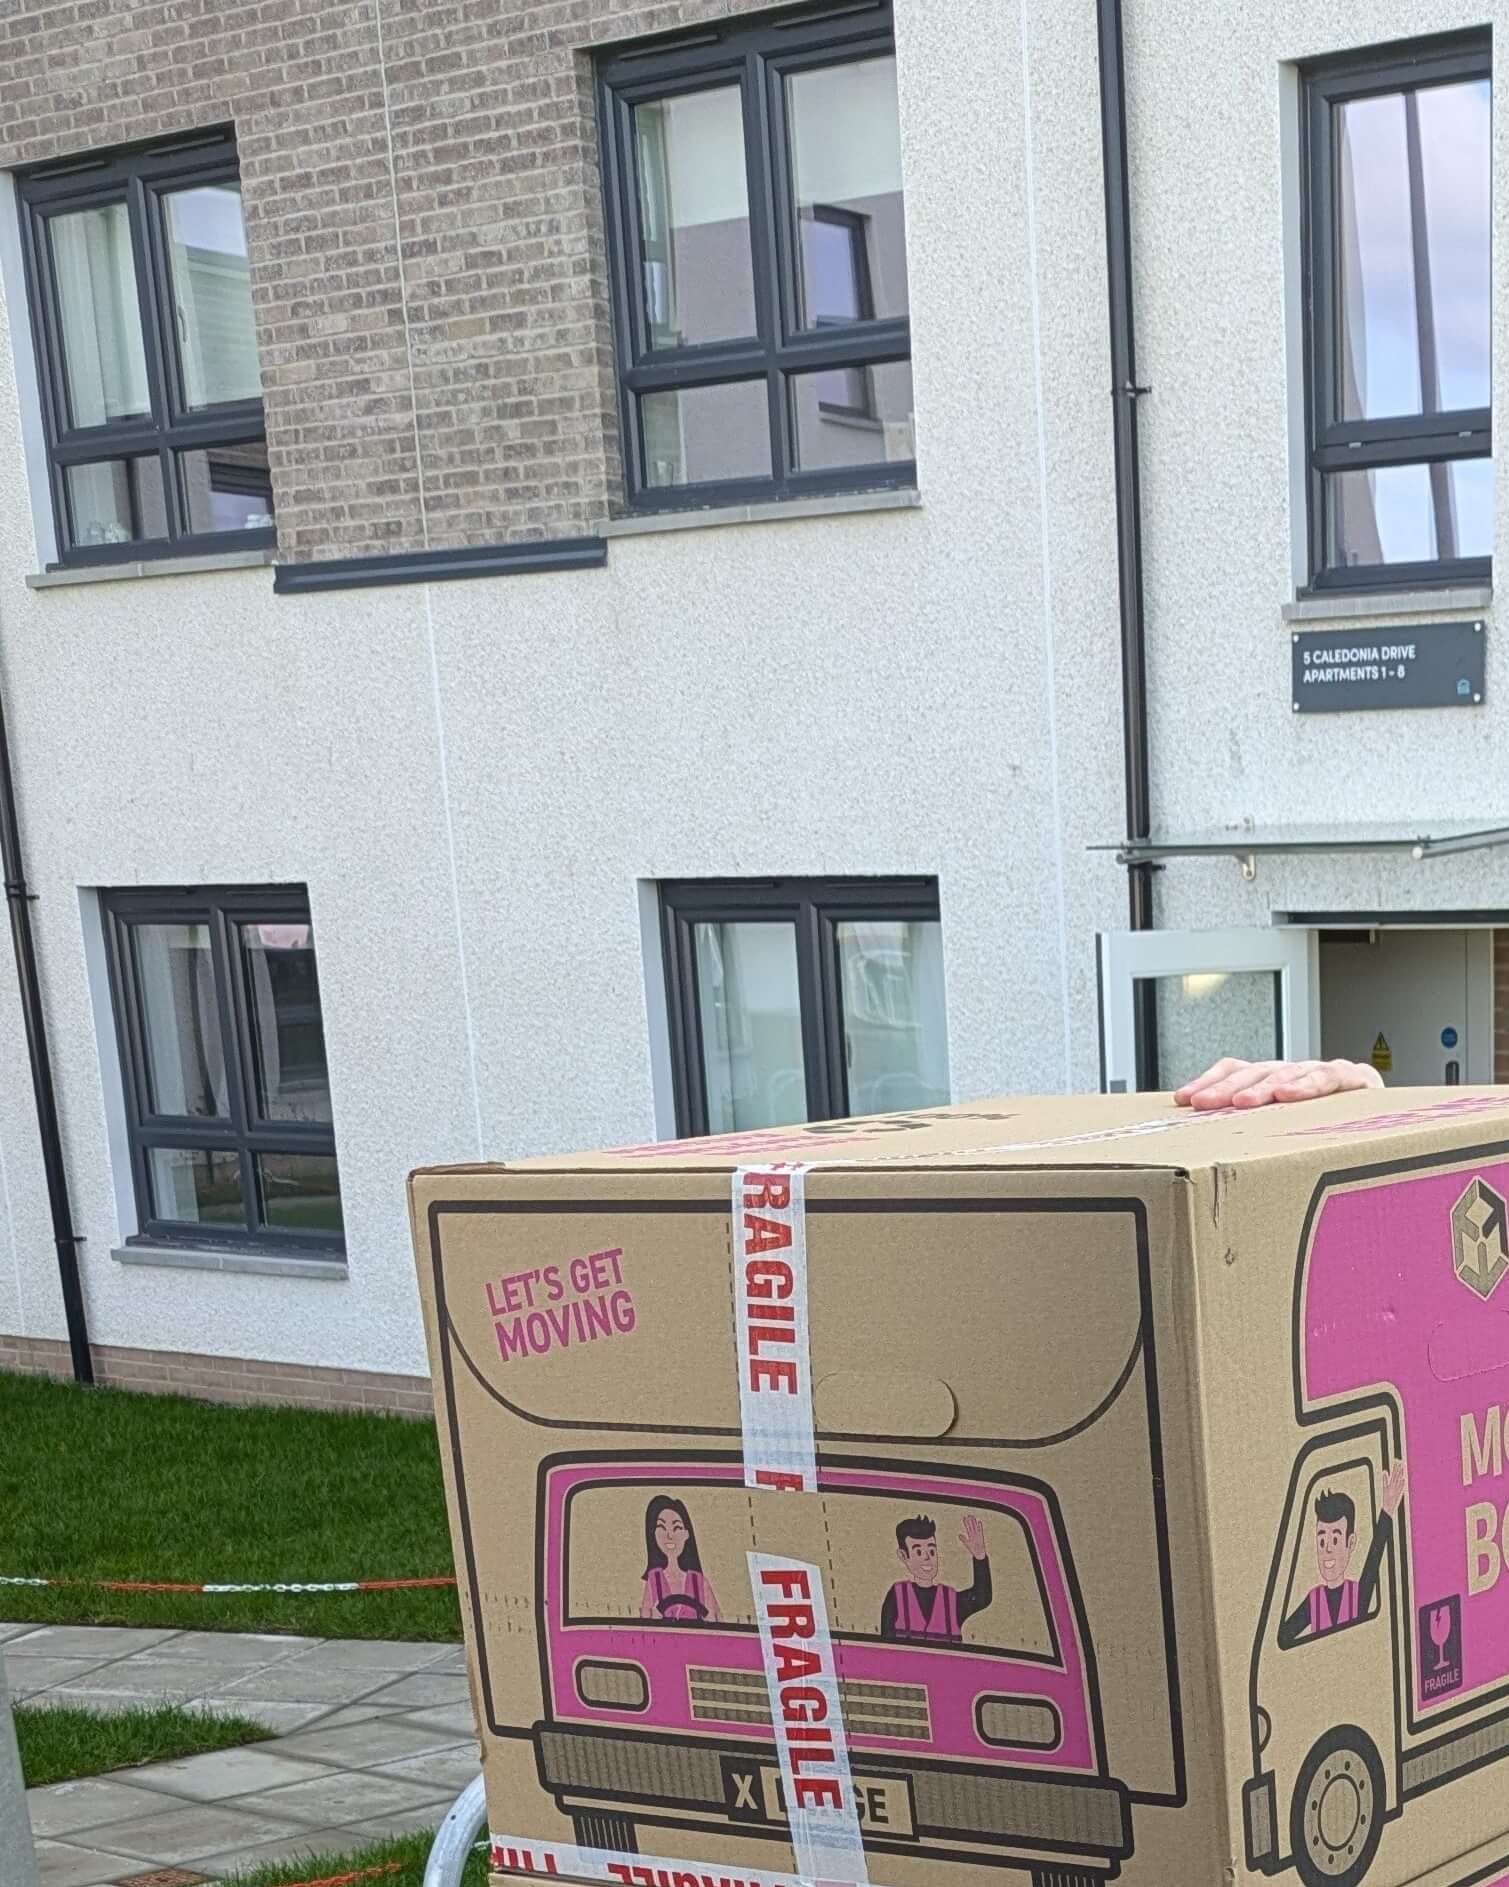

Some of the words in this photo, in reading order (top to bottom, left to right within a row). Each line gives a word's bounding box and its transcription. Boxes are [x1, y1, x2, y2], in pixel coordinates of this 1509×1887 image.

[1304, 652, 1310, 664] 5
[1313, 647, 1379, 663] CALEDONIA
[1381, 645, 1416, 660] DRIVE
[1303, 666, 1379, 683] APARTMENTS
[1381, 667, 1386, 679] 1
[485, 1265, 564, 1316] LET'S
[569, 1248, 623, 1294] GET
[495, 1290, 636, 1362] MOVING
[760, 1570, 843, 1809] FRAGILE
[1424, 1668, 1460, 1692] FRAGILE
[731, 1773, 758, 1810] X
